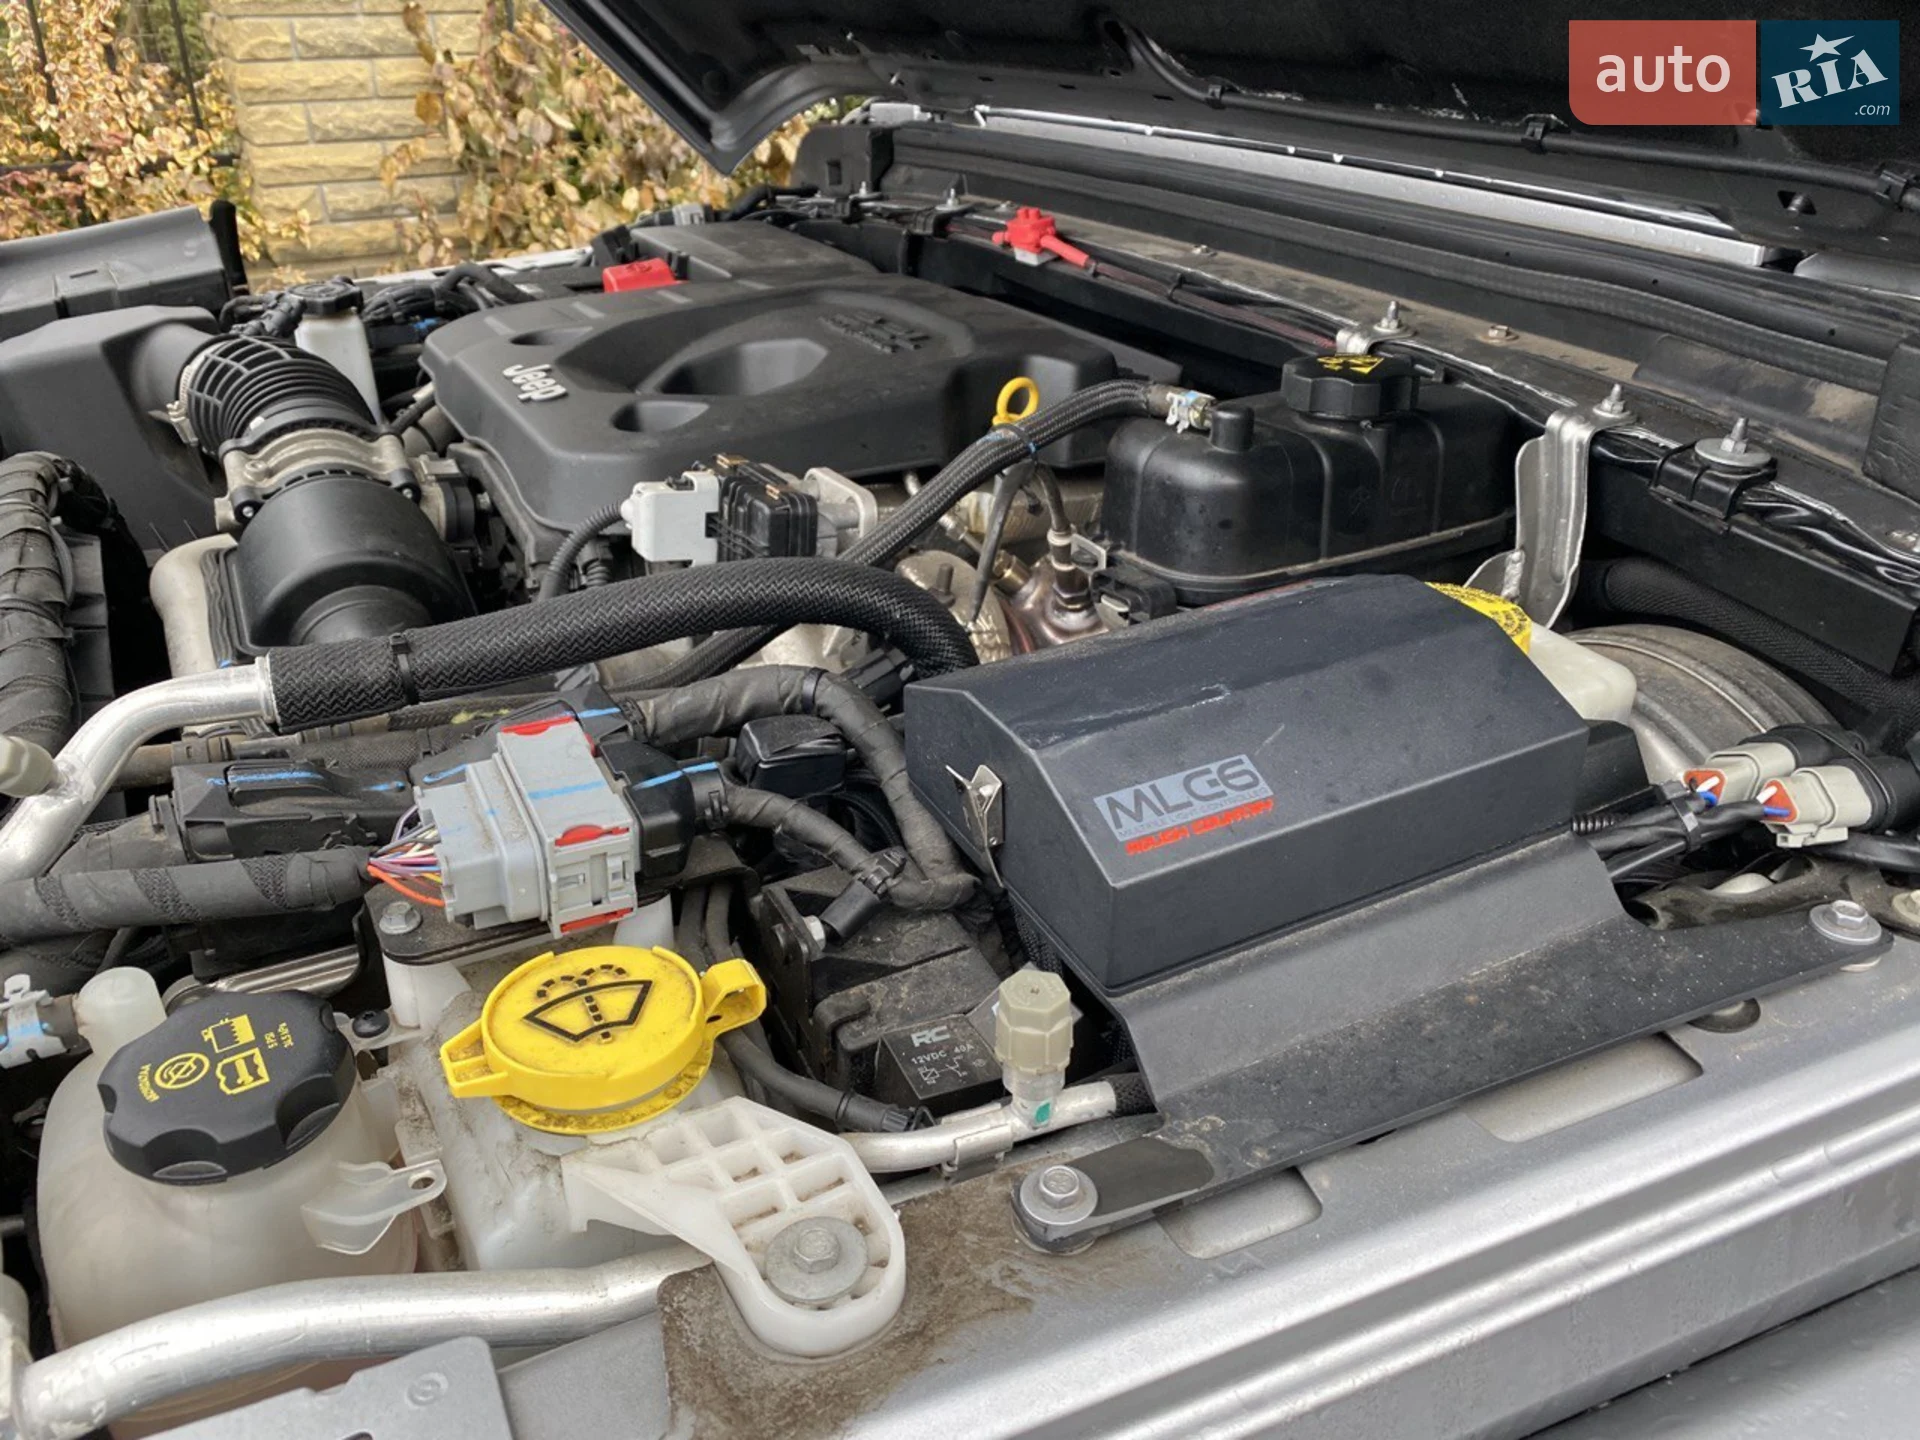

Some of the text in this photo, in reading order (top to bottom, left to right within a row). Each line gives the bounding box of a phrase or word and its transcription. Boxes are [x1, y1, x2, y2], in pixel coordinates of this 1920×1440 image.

[503, 364, 567, 400] Jeep
[911, 1025, 950, 1047] RC
[911, 1050, 947, 1064] 12VDC
